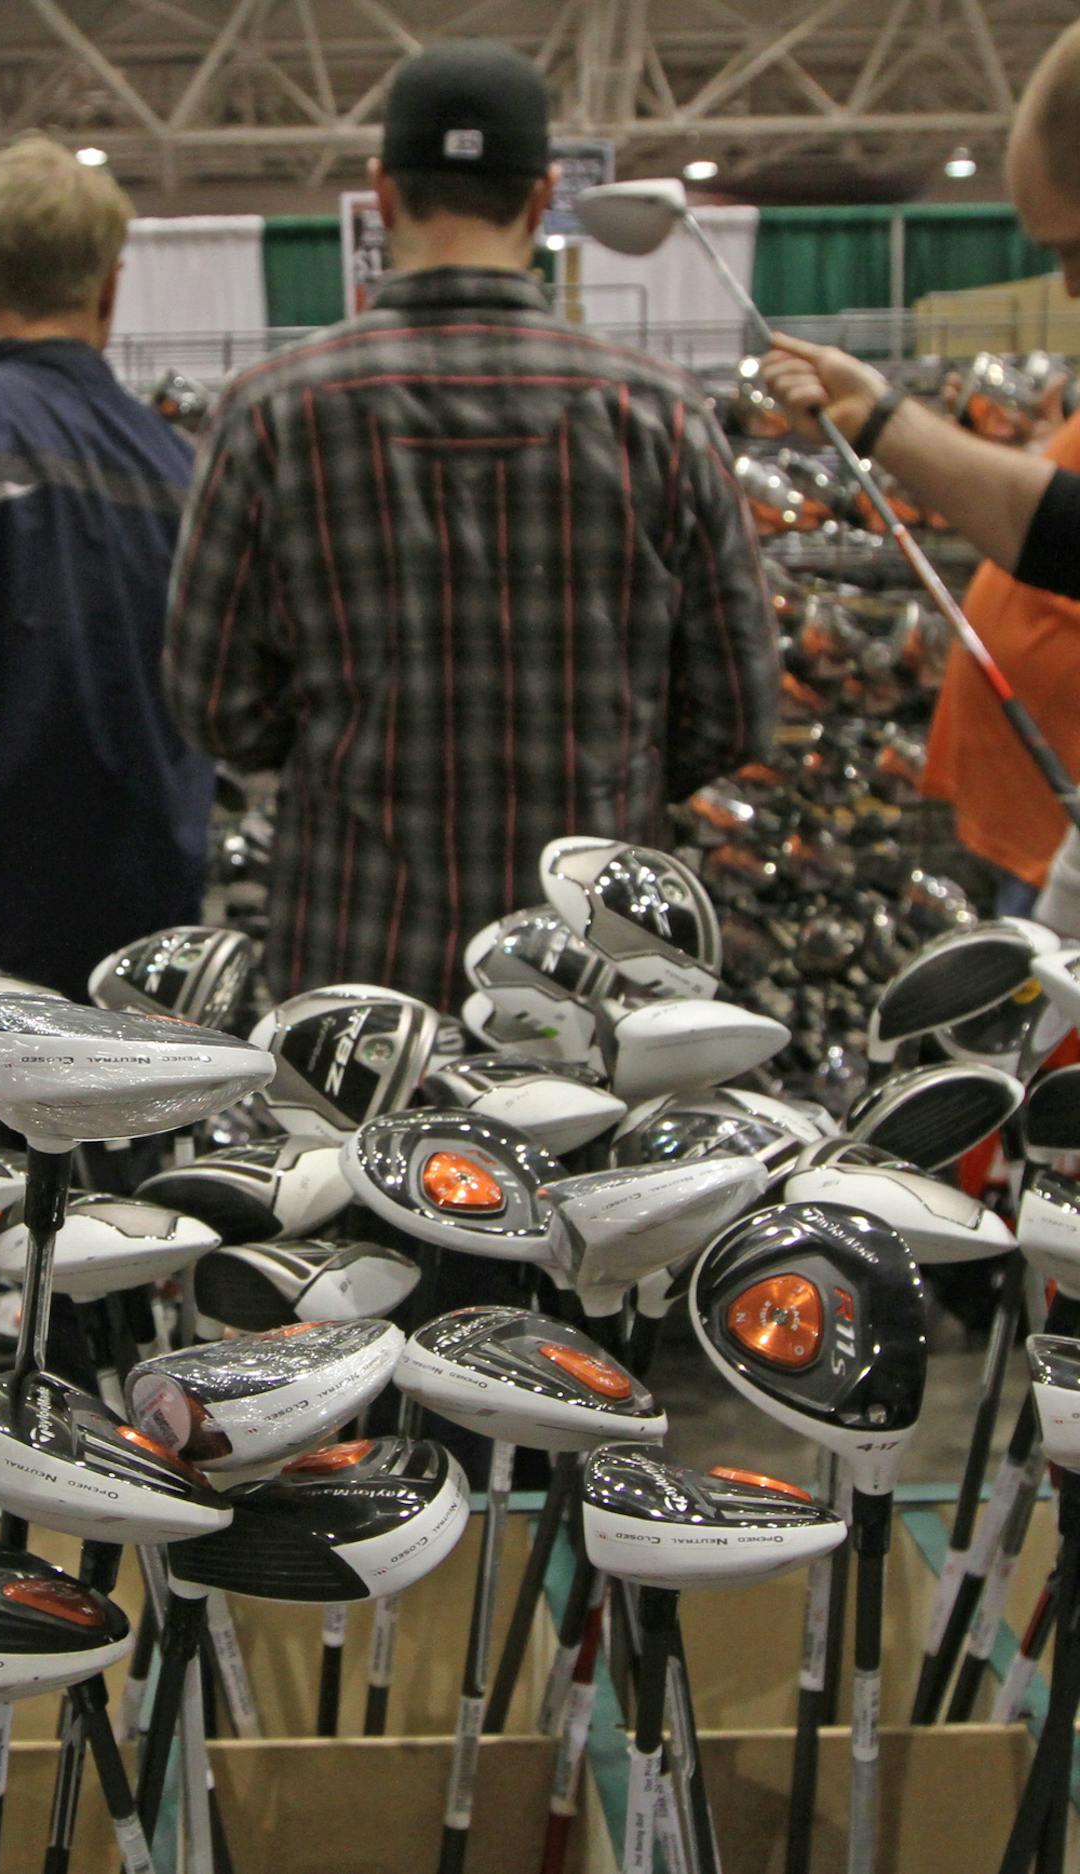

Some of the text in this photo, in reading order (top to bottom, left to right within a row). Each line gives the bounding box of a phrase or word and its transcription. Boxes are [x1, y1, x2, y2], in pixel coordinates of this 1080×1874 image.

[324, 1006, 372, 1097] RBZ
[831, 1286, 857, 1377] R11S
[5, 1457, 58, 1484] NEUTRAL
[390, 1535, 429, 1564] CLOSED
[672, 1536, 729, 1547] NEUTRAL
